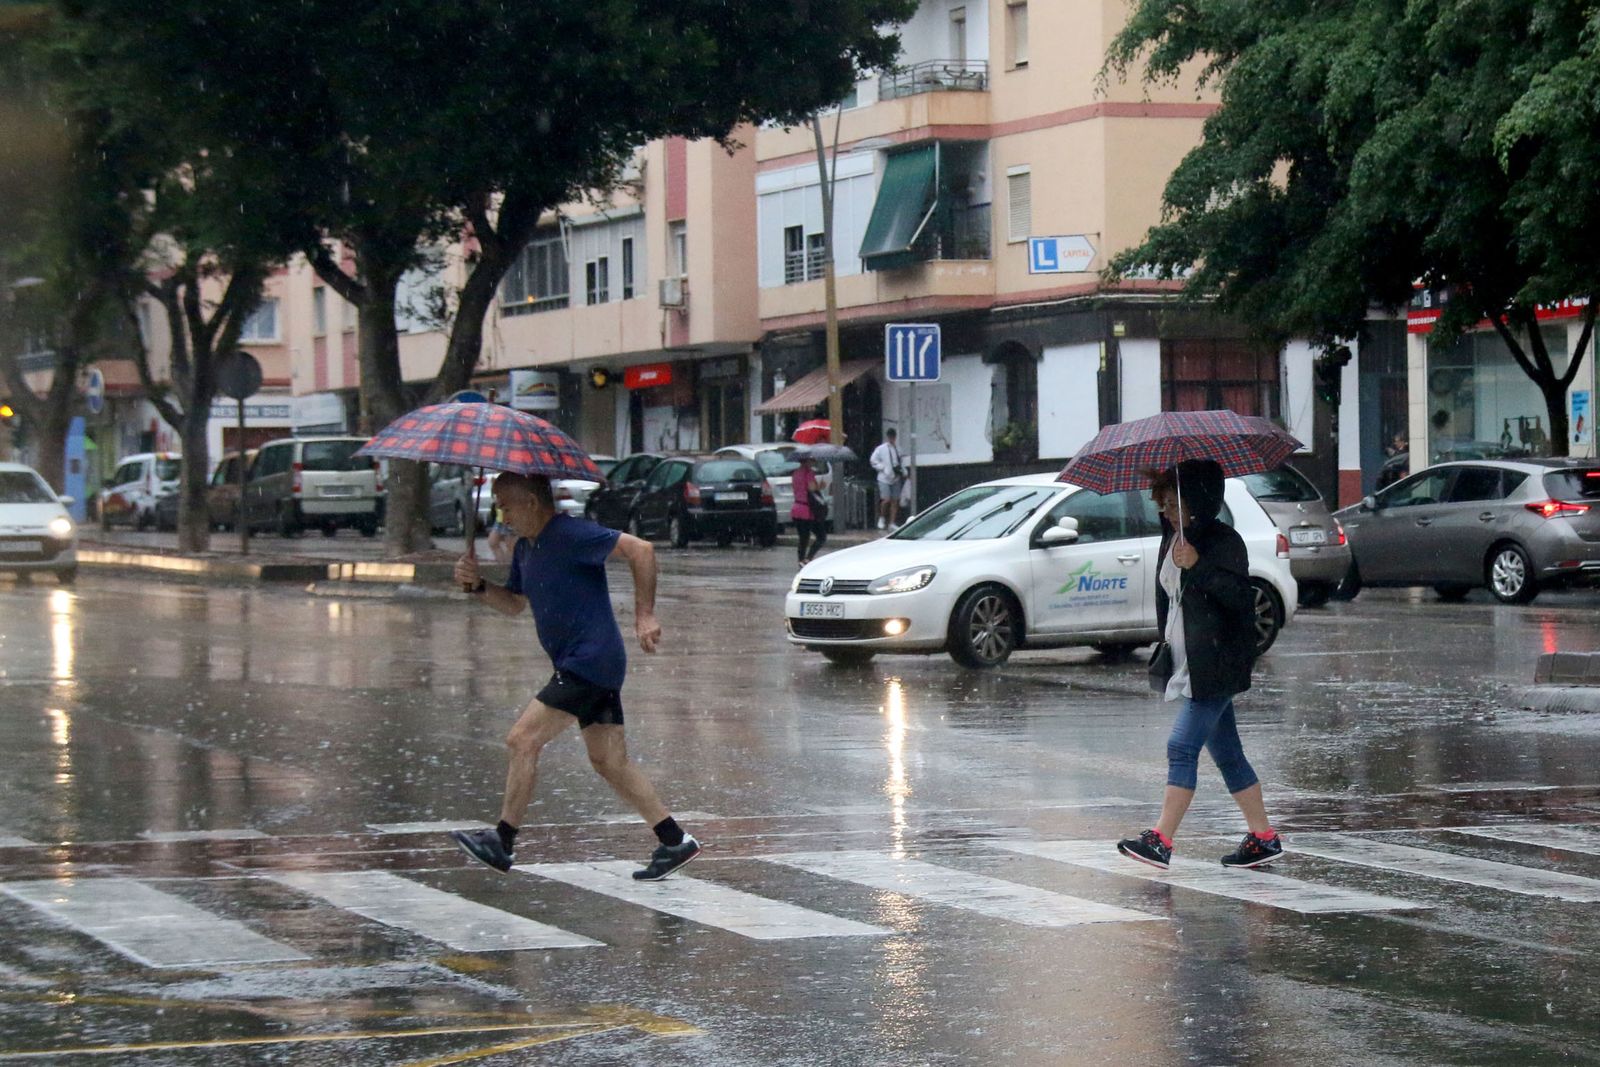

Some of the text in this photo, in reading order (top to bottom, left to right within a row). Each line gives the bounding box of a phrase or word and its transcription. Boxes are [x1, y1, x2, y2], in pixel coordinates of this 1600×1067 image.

[1038, 242, 1089, 266] L CAPITAL
[1077, 575, 1128, 592] NORTE
